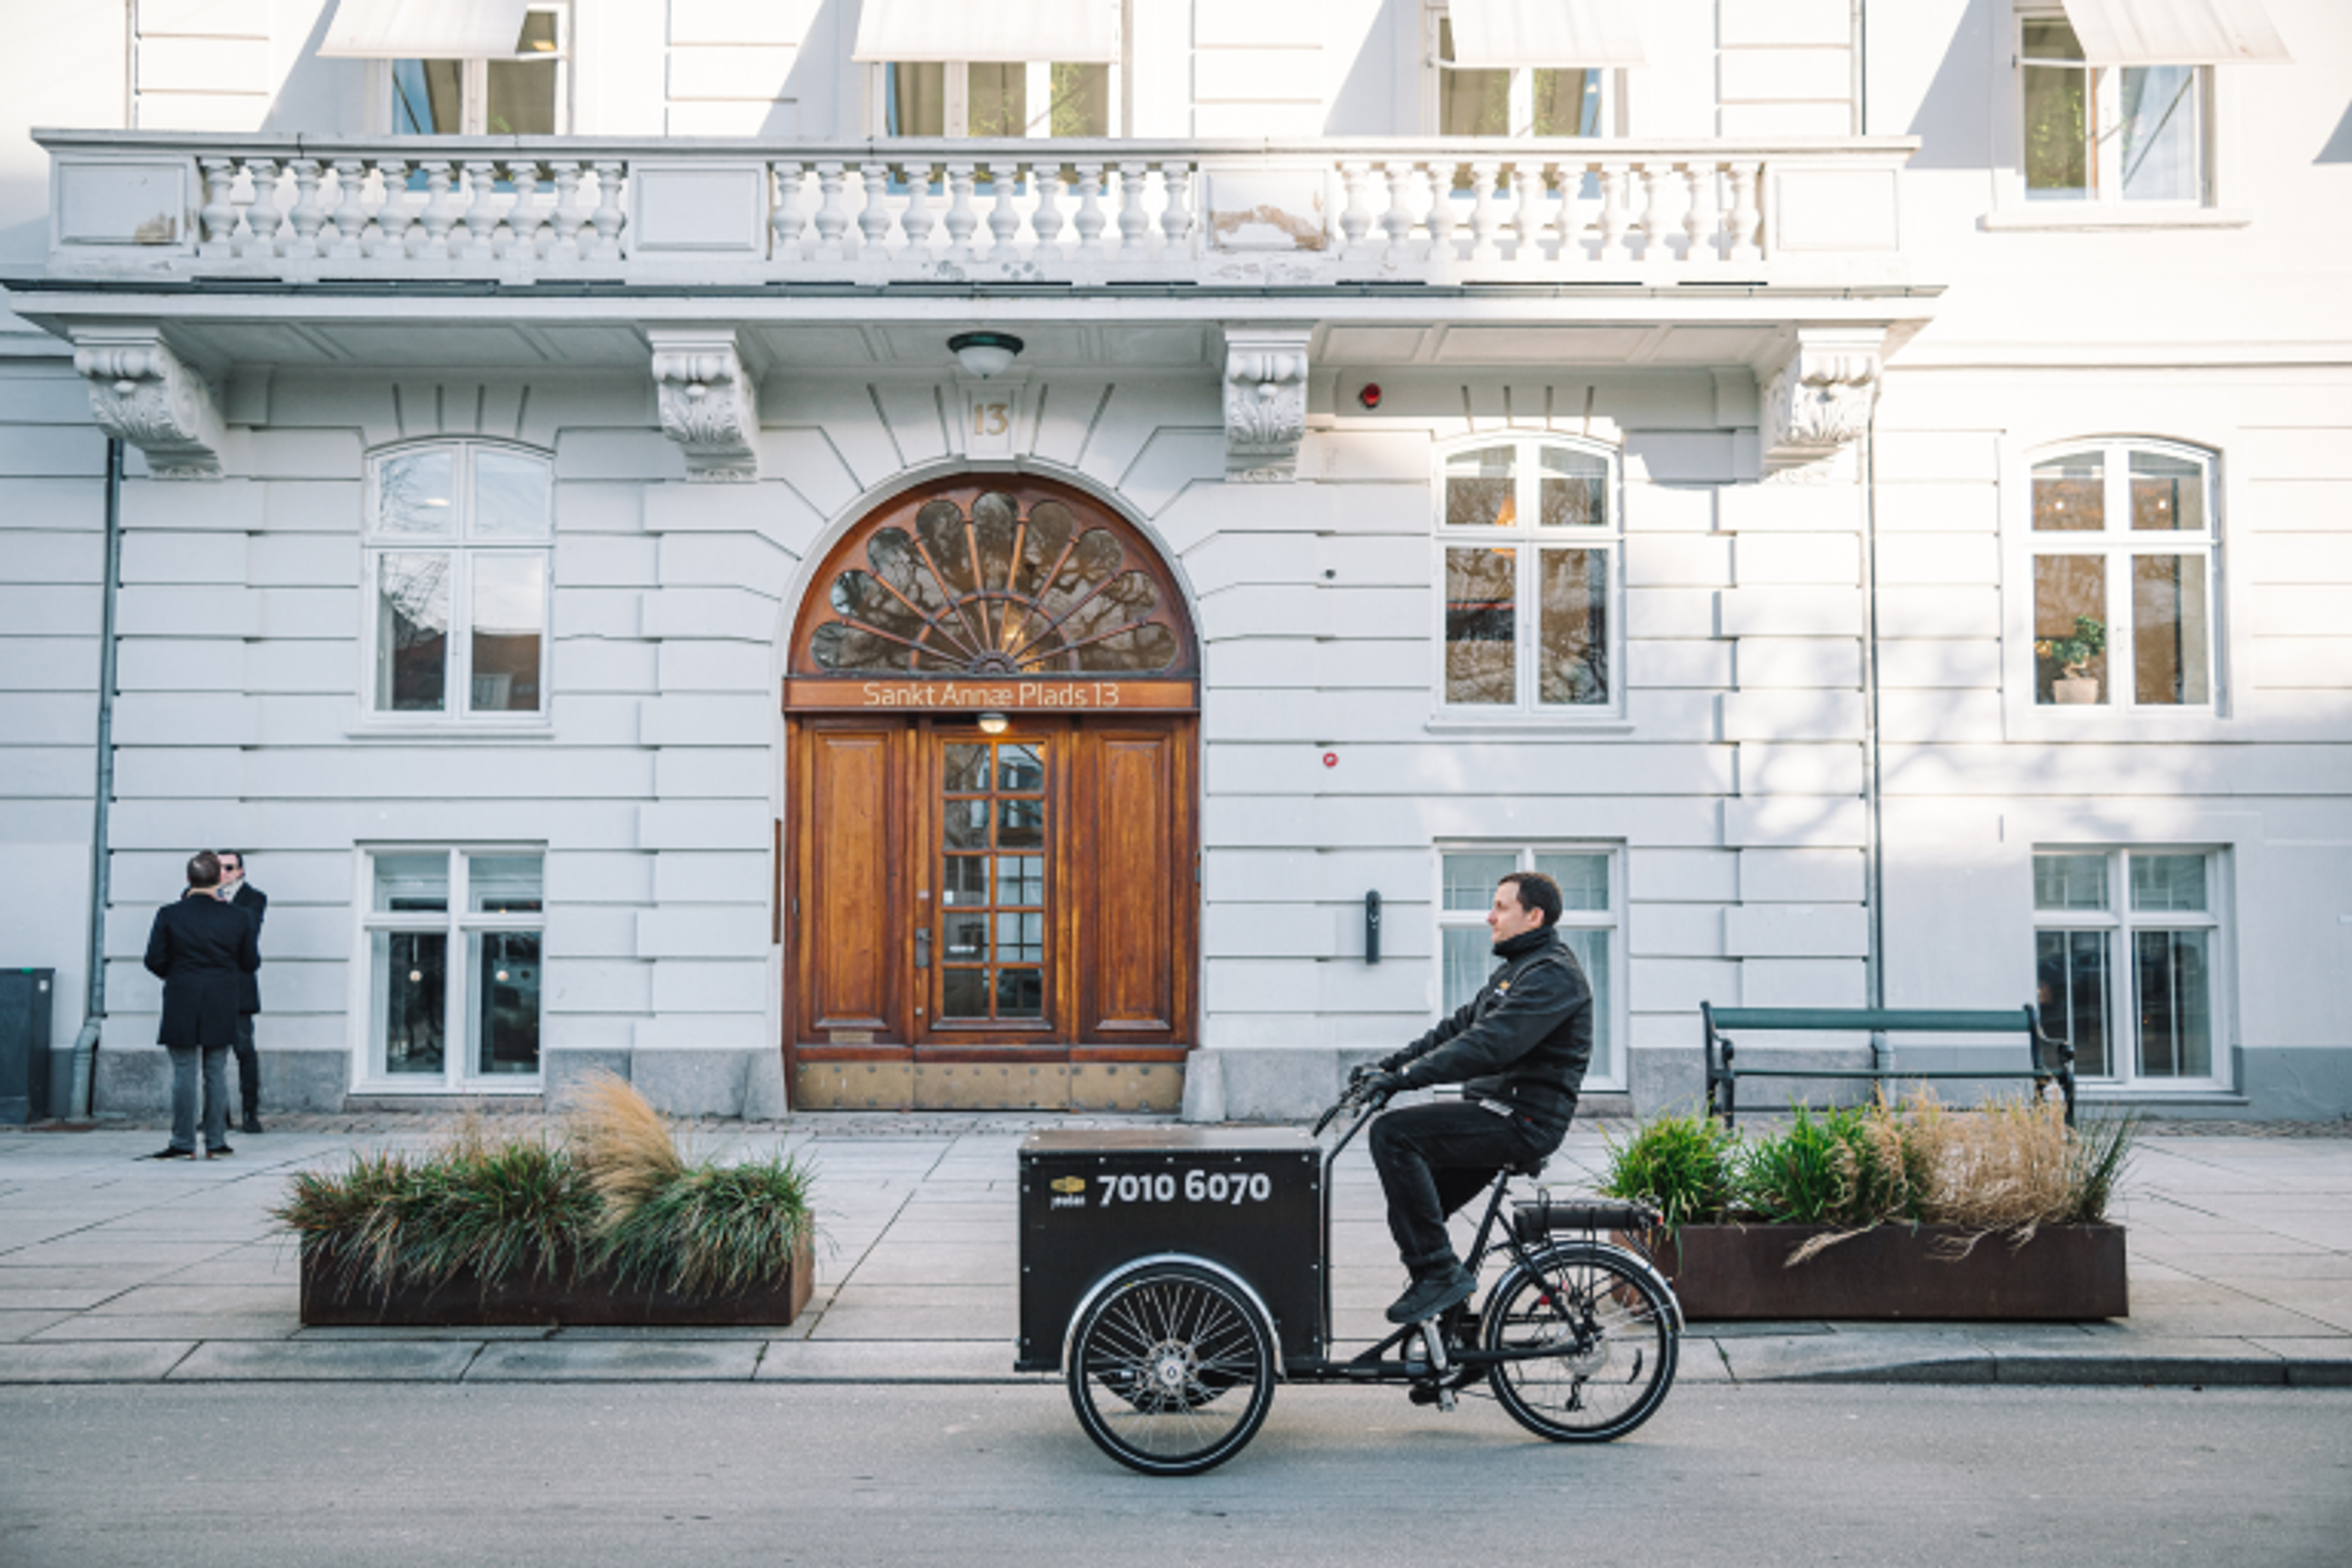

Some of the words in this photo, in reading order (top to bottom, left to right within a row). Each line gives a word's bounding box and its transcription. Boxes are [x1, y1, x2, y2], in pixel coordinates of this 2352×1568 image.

[974, 403, 1009, 435] 13
[863, 681, 935, 706] Sankt
[940, 682, 1013, 706] Annæ
[1019, 682, 1088, 706] Plads
[1093, 682, 1119, 706] 13
[1096, 1173, 1176, 1207] 7010
[1184, 1169, 1272, 1205] 6070
